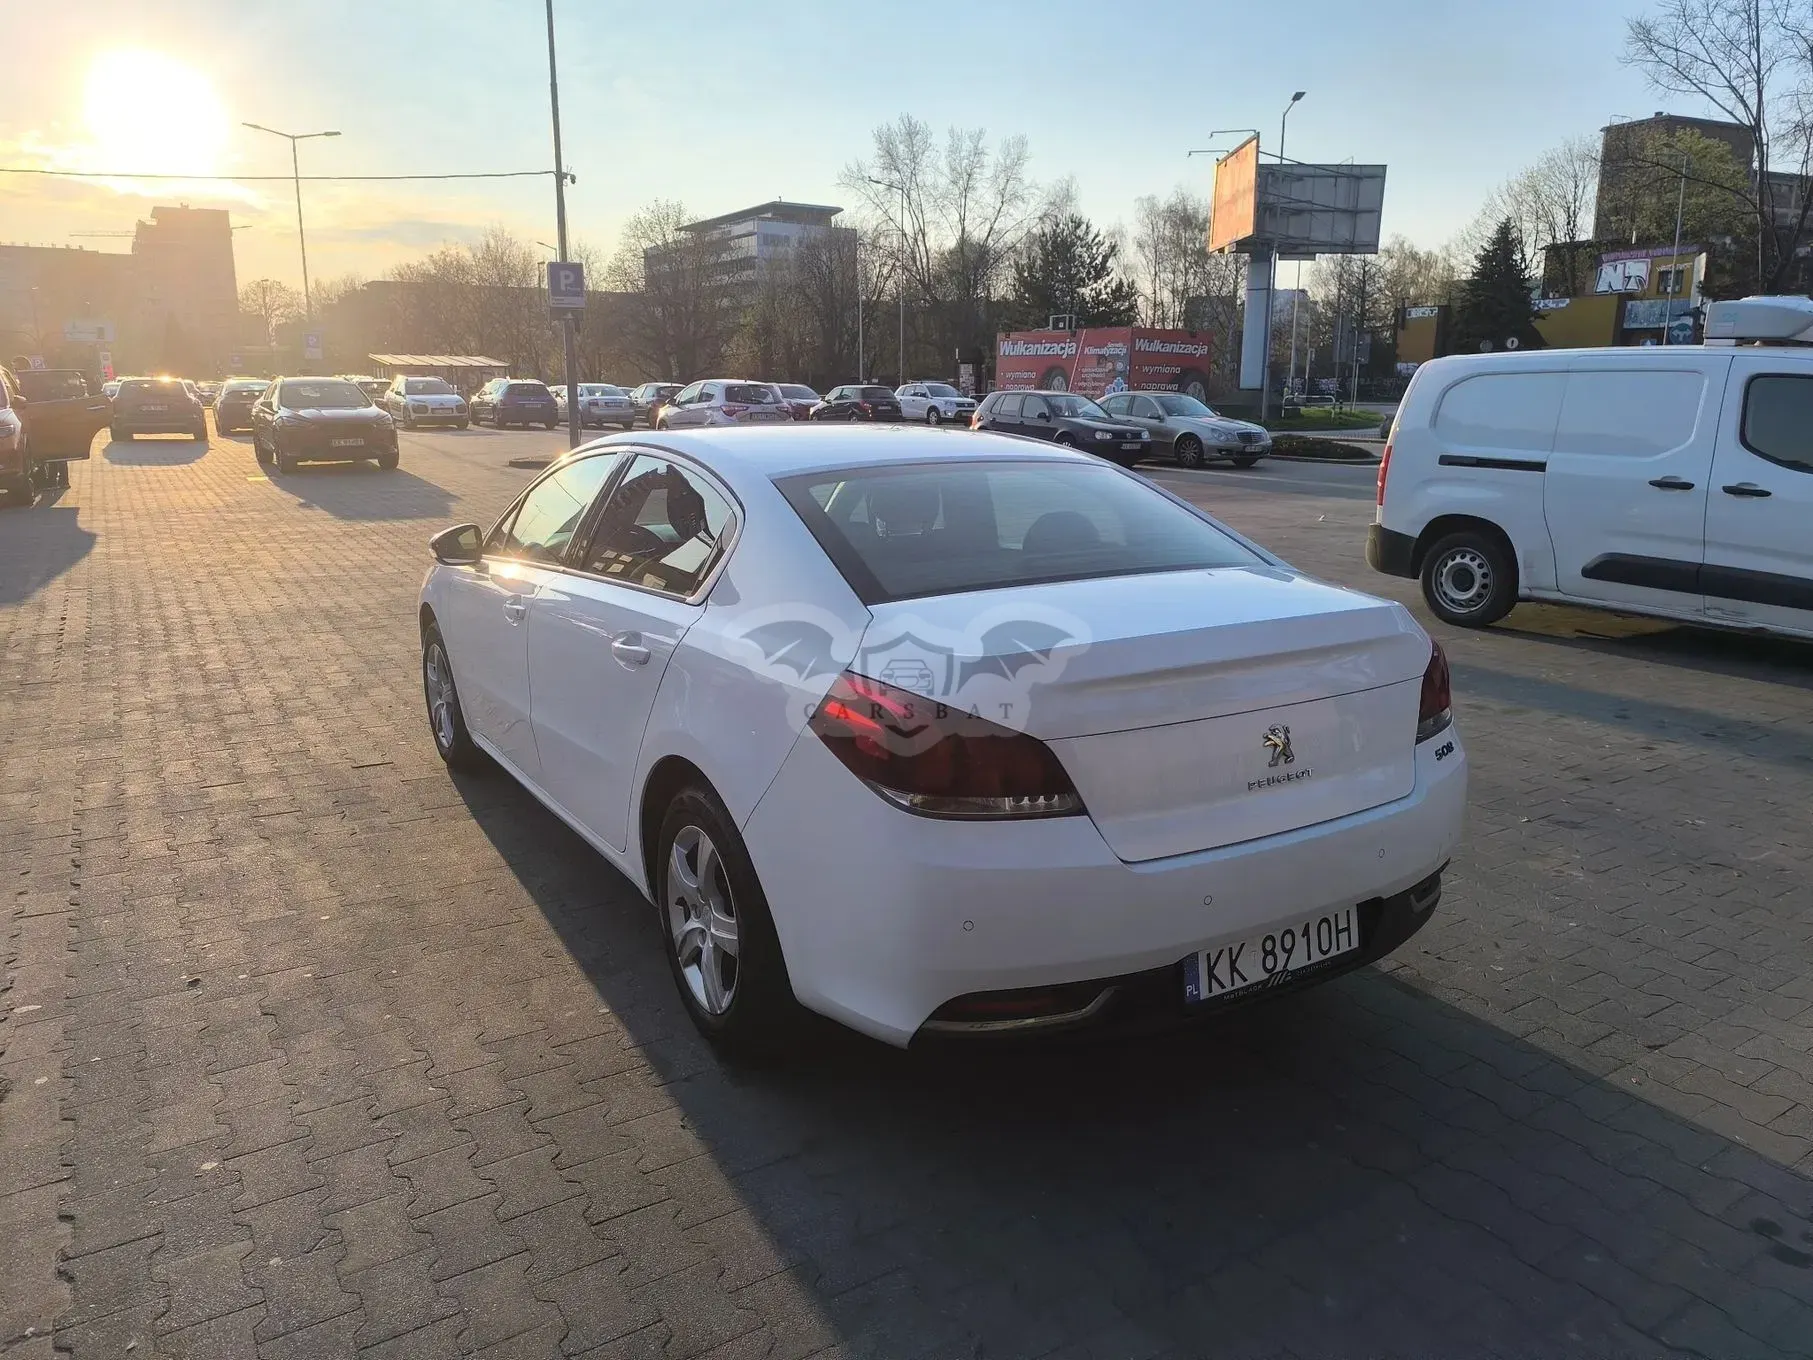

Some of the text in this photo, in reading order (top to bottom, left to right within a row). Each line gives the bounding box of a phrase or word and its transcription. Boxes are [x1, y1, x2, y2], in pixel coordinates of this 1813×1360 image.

[560, 270, 575, 291] P
[999, 338, 1077, 359] Wulkanizacja
[1134, 338, 1209, 358] Wulkanizacja
[1005, 370, 1037, 380] wymiana
[1141, 363, 1181, 375] wymiana
[1434, 740, 1455, 761] 508
[1247, 767, 1315, 791] PEUGEOT
[1206, 909, 1353, 994] KK 8910H
[1186, 984, 1198, 996] PL
